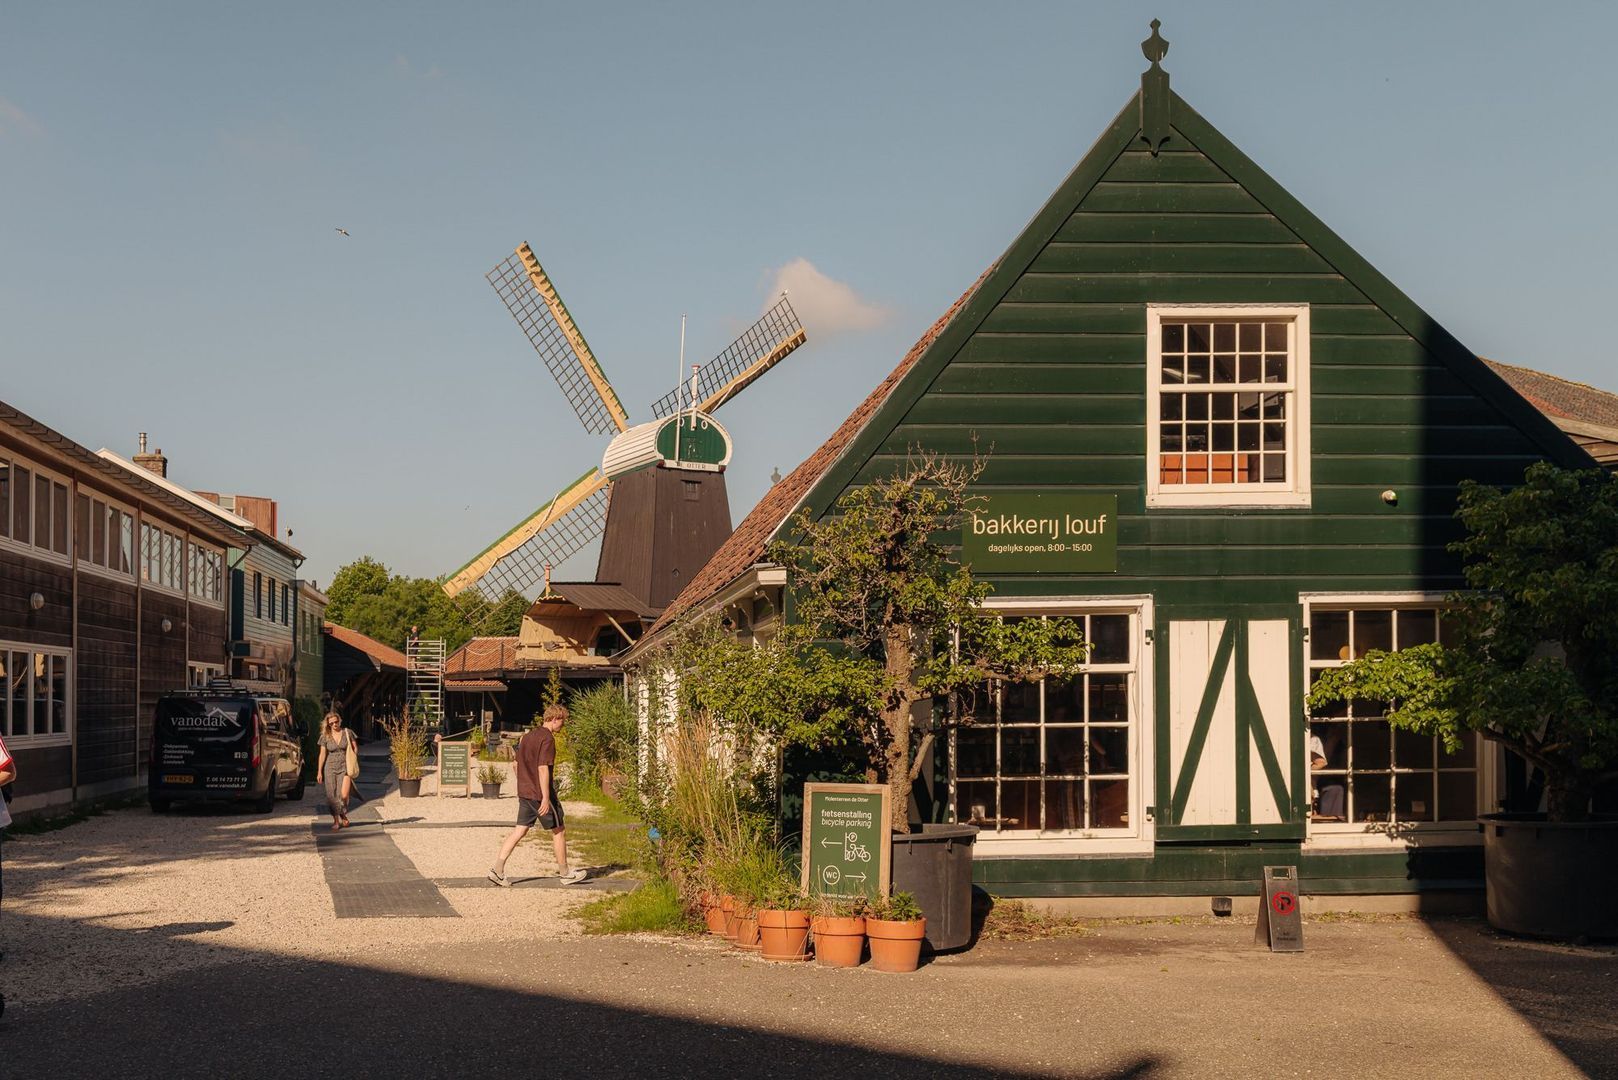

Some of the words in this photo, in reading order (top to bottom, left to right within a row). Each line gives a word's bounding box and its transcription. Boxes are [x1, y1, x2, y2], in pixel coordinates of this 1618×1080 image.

[686, 462, 706, 470] OTTER
[973, 514, 1059, 540] bakkerij
[1065, 514, 1107, 535] louf
[988, 543, 1023, 554] dagelijks
[171, 714, 228, 727] vanodak
[822, 809, 872, 820] fietsenstalling
[822, 818, 845, 828] bicycle
[846, 820, 872, 829] parking
[826, 871, 838, 879] WC
